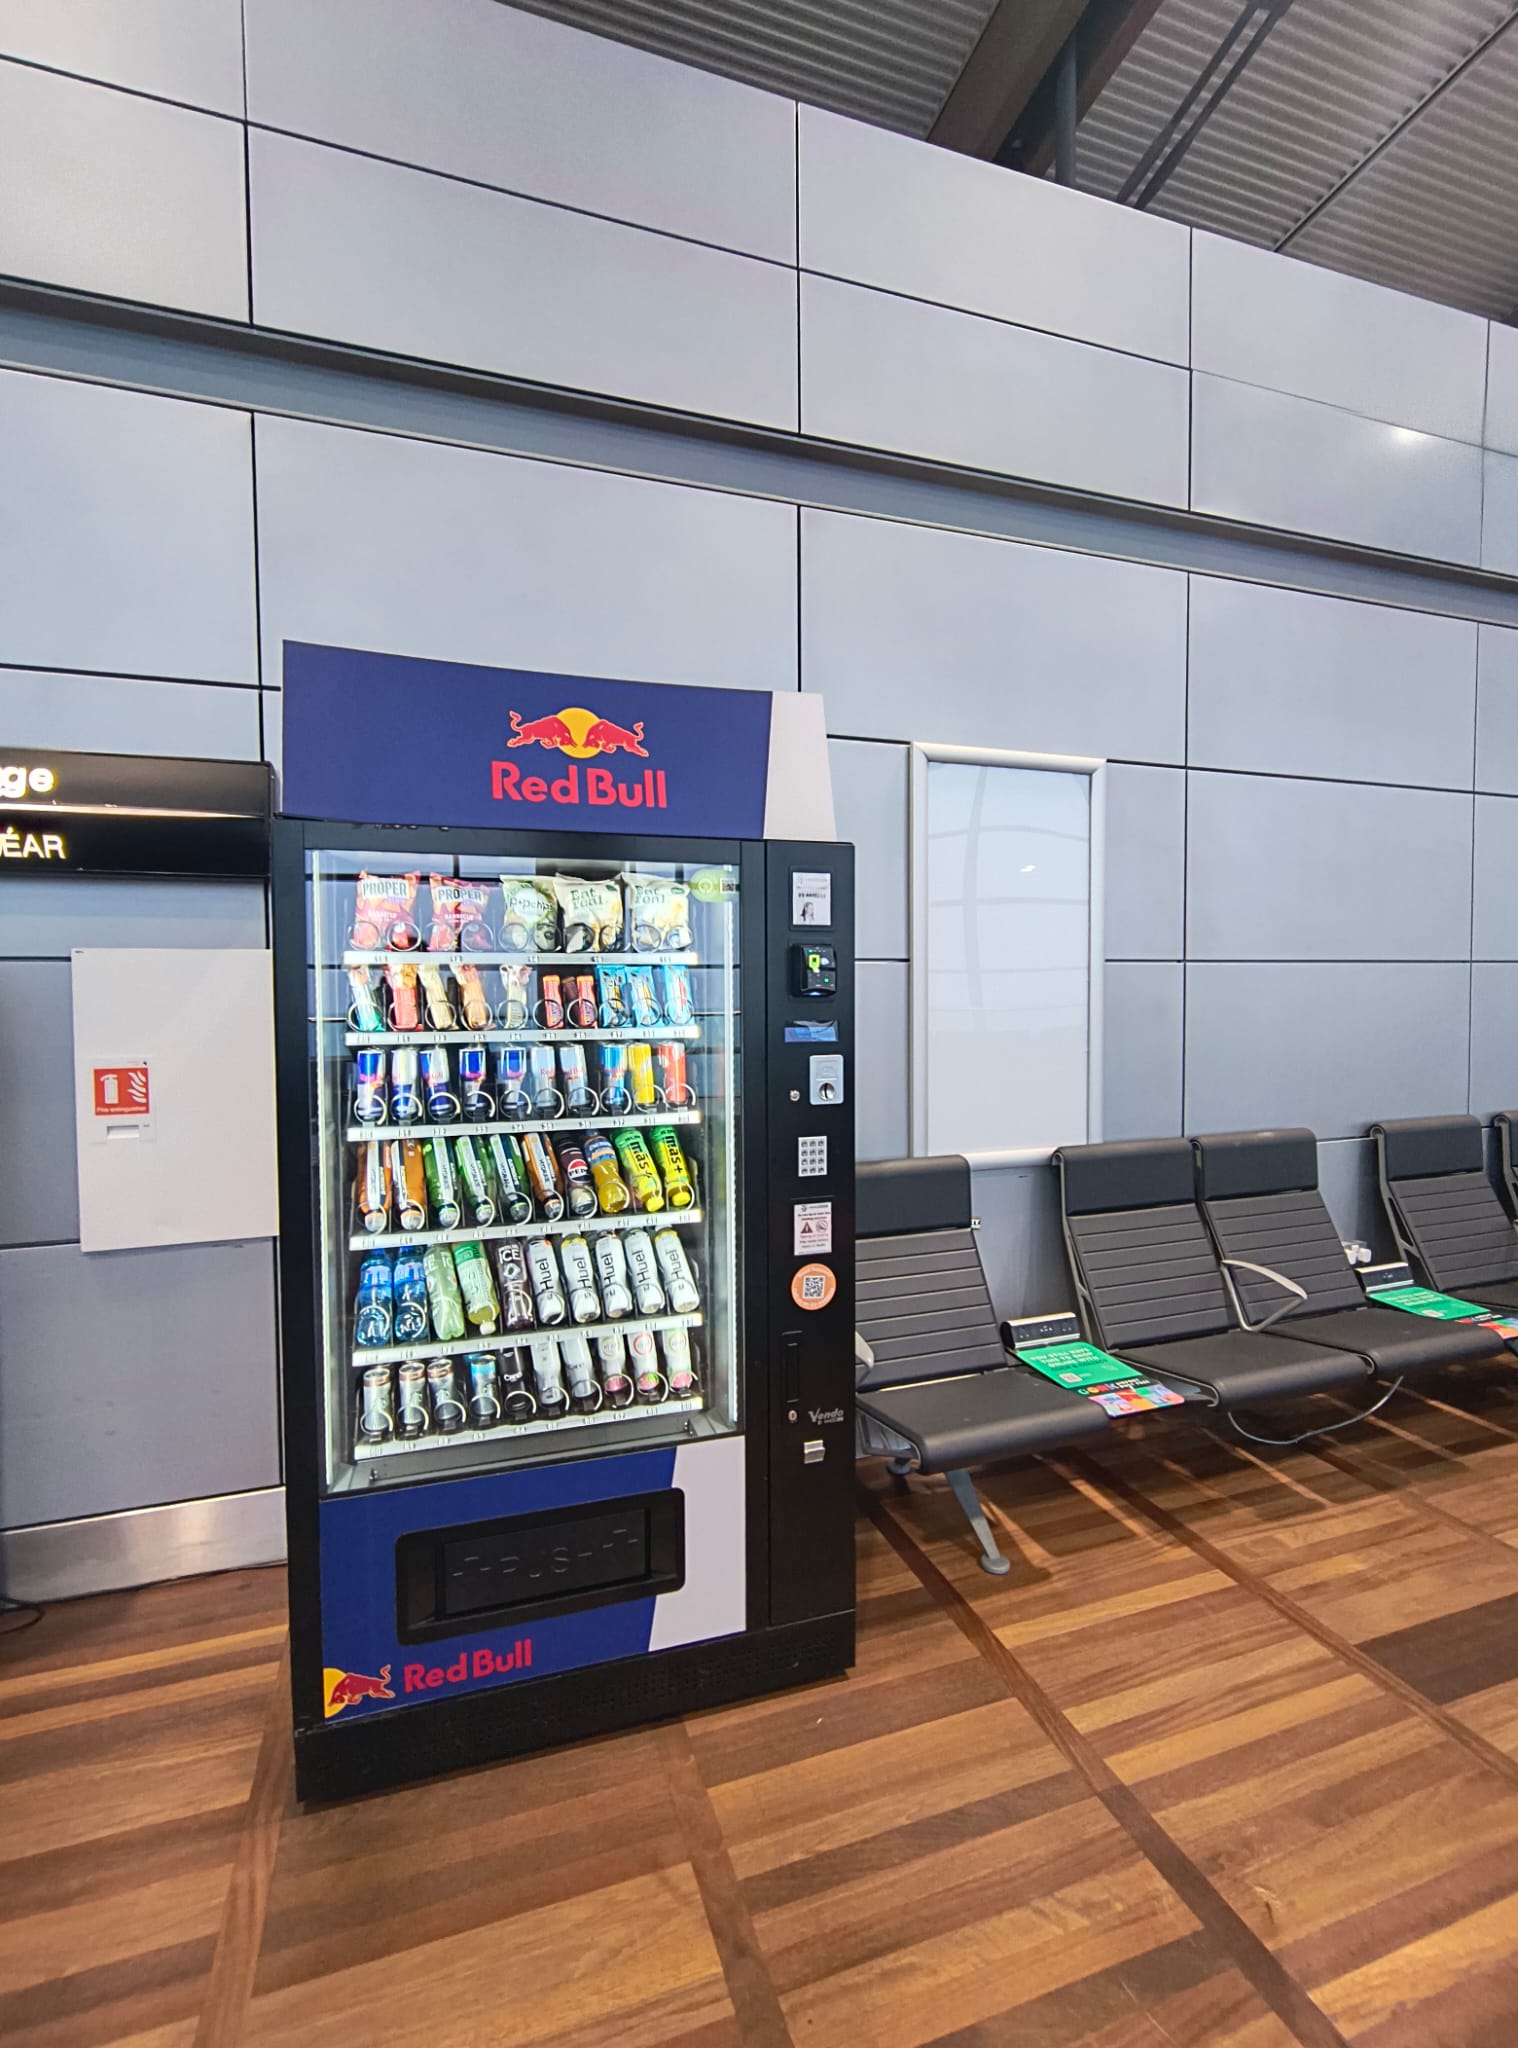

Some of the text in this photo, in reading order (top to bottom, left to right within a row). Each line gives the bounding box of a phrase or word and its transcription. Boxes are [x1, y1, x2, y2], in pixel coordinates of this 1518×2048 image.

[0, 766, 55, 799] ge
[491, 760, 668, 809] Red Bull
[0, 826, 66, 859] ÉAR
[362, 880, 407, 897] PROPER
[438, 888, 483, 904] PROPER
[498, 1247, 521, 1264] ICE
[600, 1252, 616, 1288] Huel
[631, 1249, 651, 1284] Huel
[665, 1248, 685, 1280] Huel
[535, 1257, 555, 1292] Huel
[573, 1257, 593, 1289] Huel
[808, 1407, 844, 1424] Vendo
[403, 1638, 533, 1694] Red Bull
